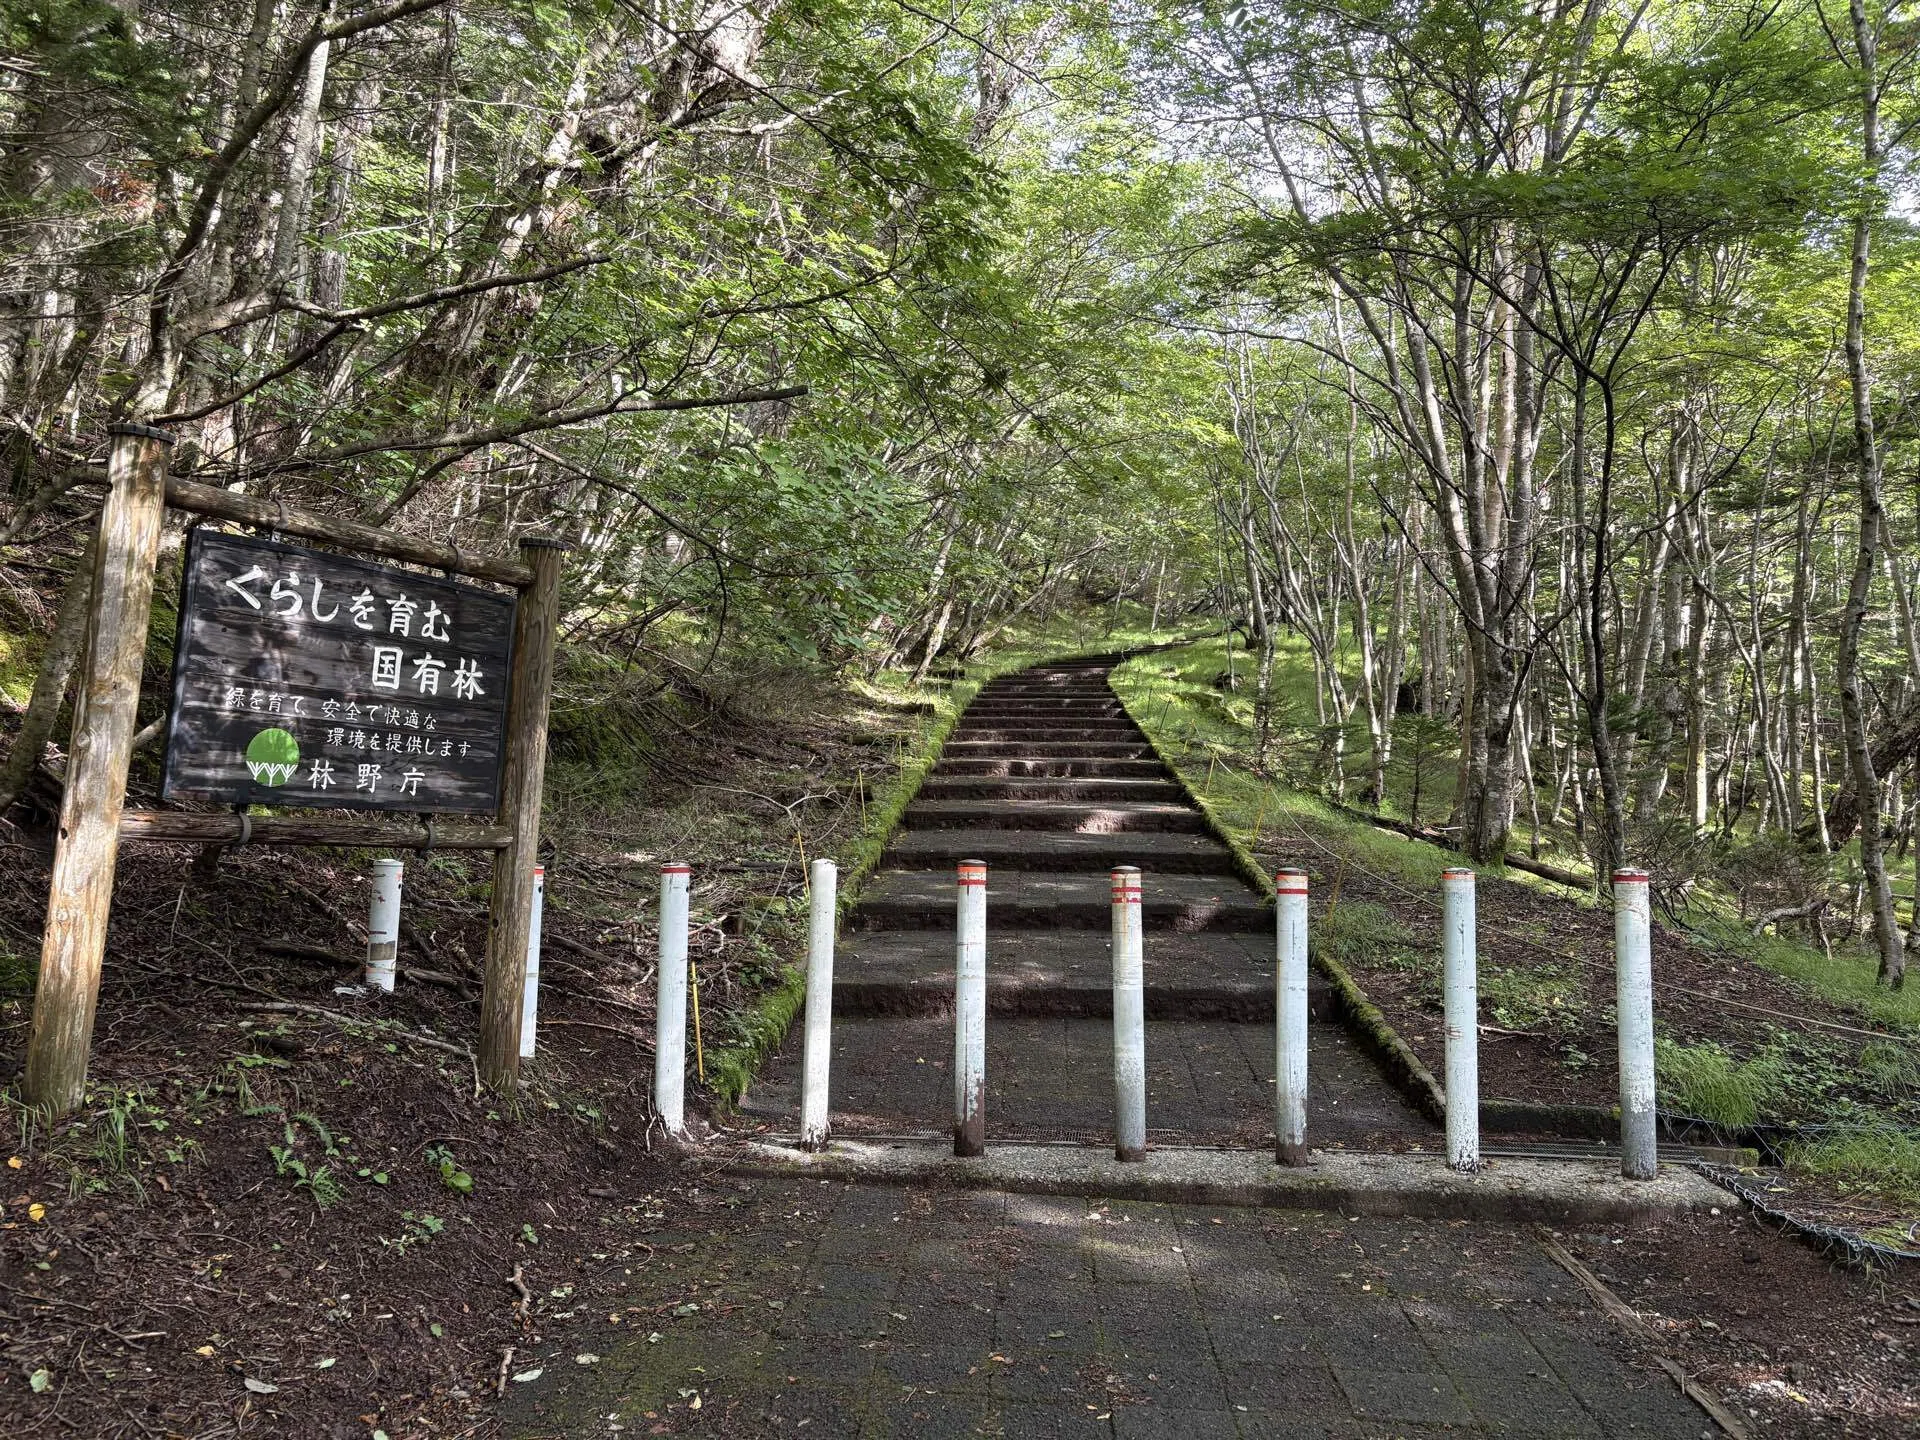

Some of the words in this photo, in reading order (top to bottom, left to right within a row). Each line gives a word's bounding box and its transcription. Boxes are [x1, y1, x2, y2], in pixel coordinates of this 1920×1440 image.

[225, 566, 450, 642] くらしを育む
[371, 647, 486, 700] 国有林
[327, 729, 472, 757] 環境を提供します
[308, 759, 426, 796] 林野庁
